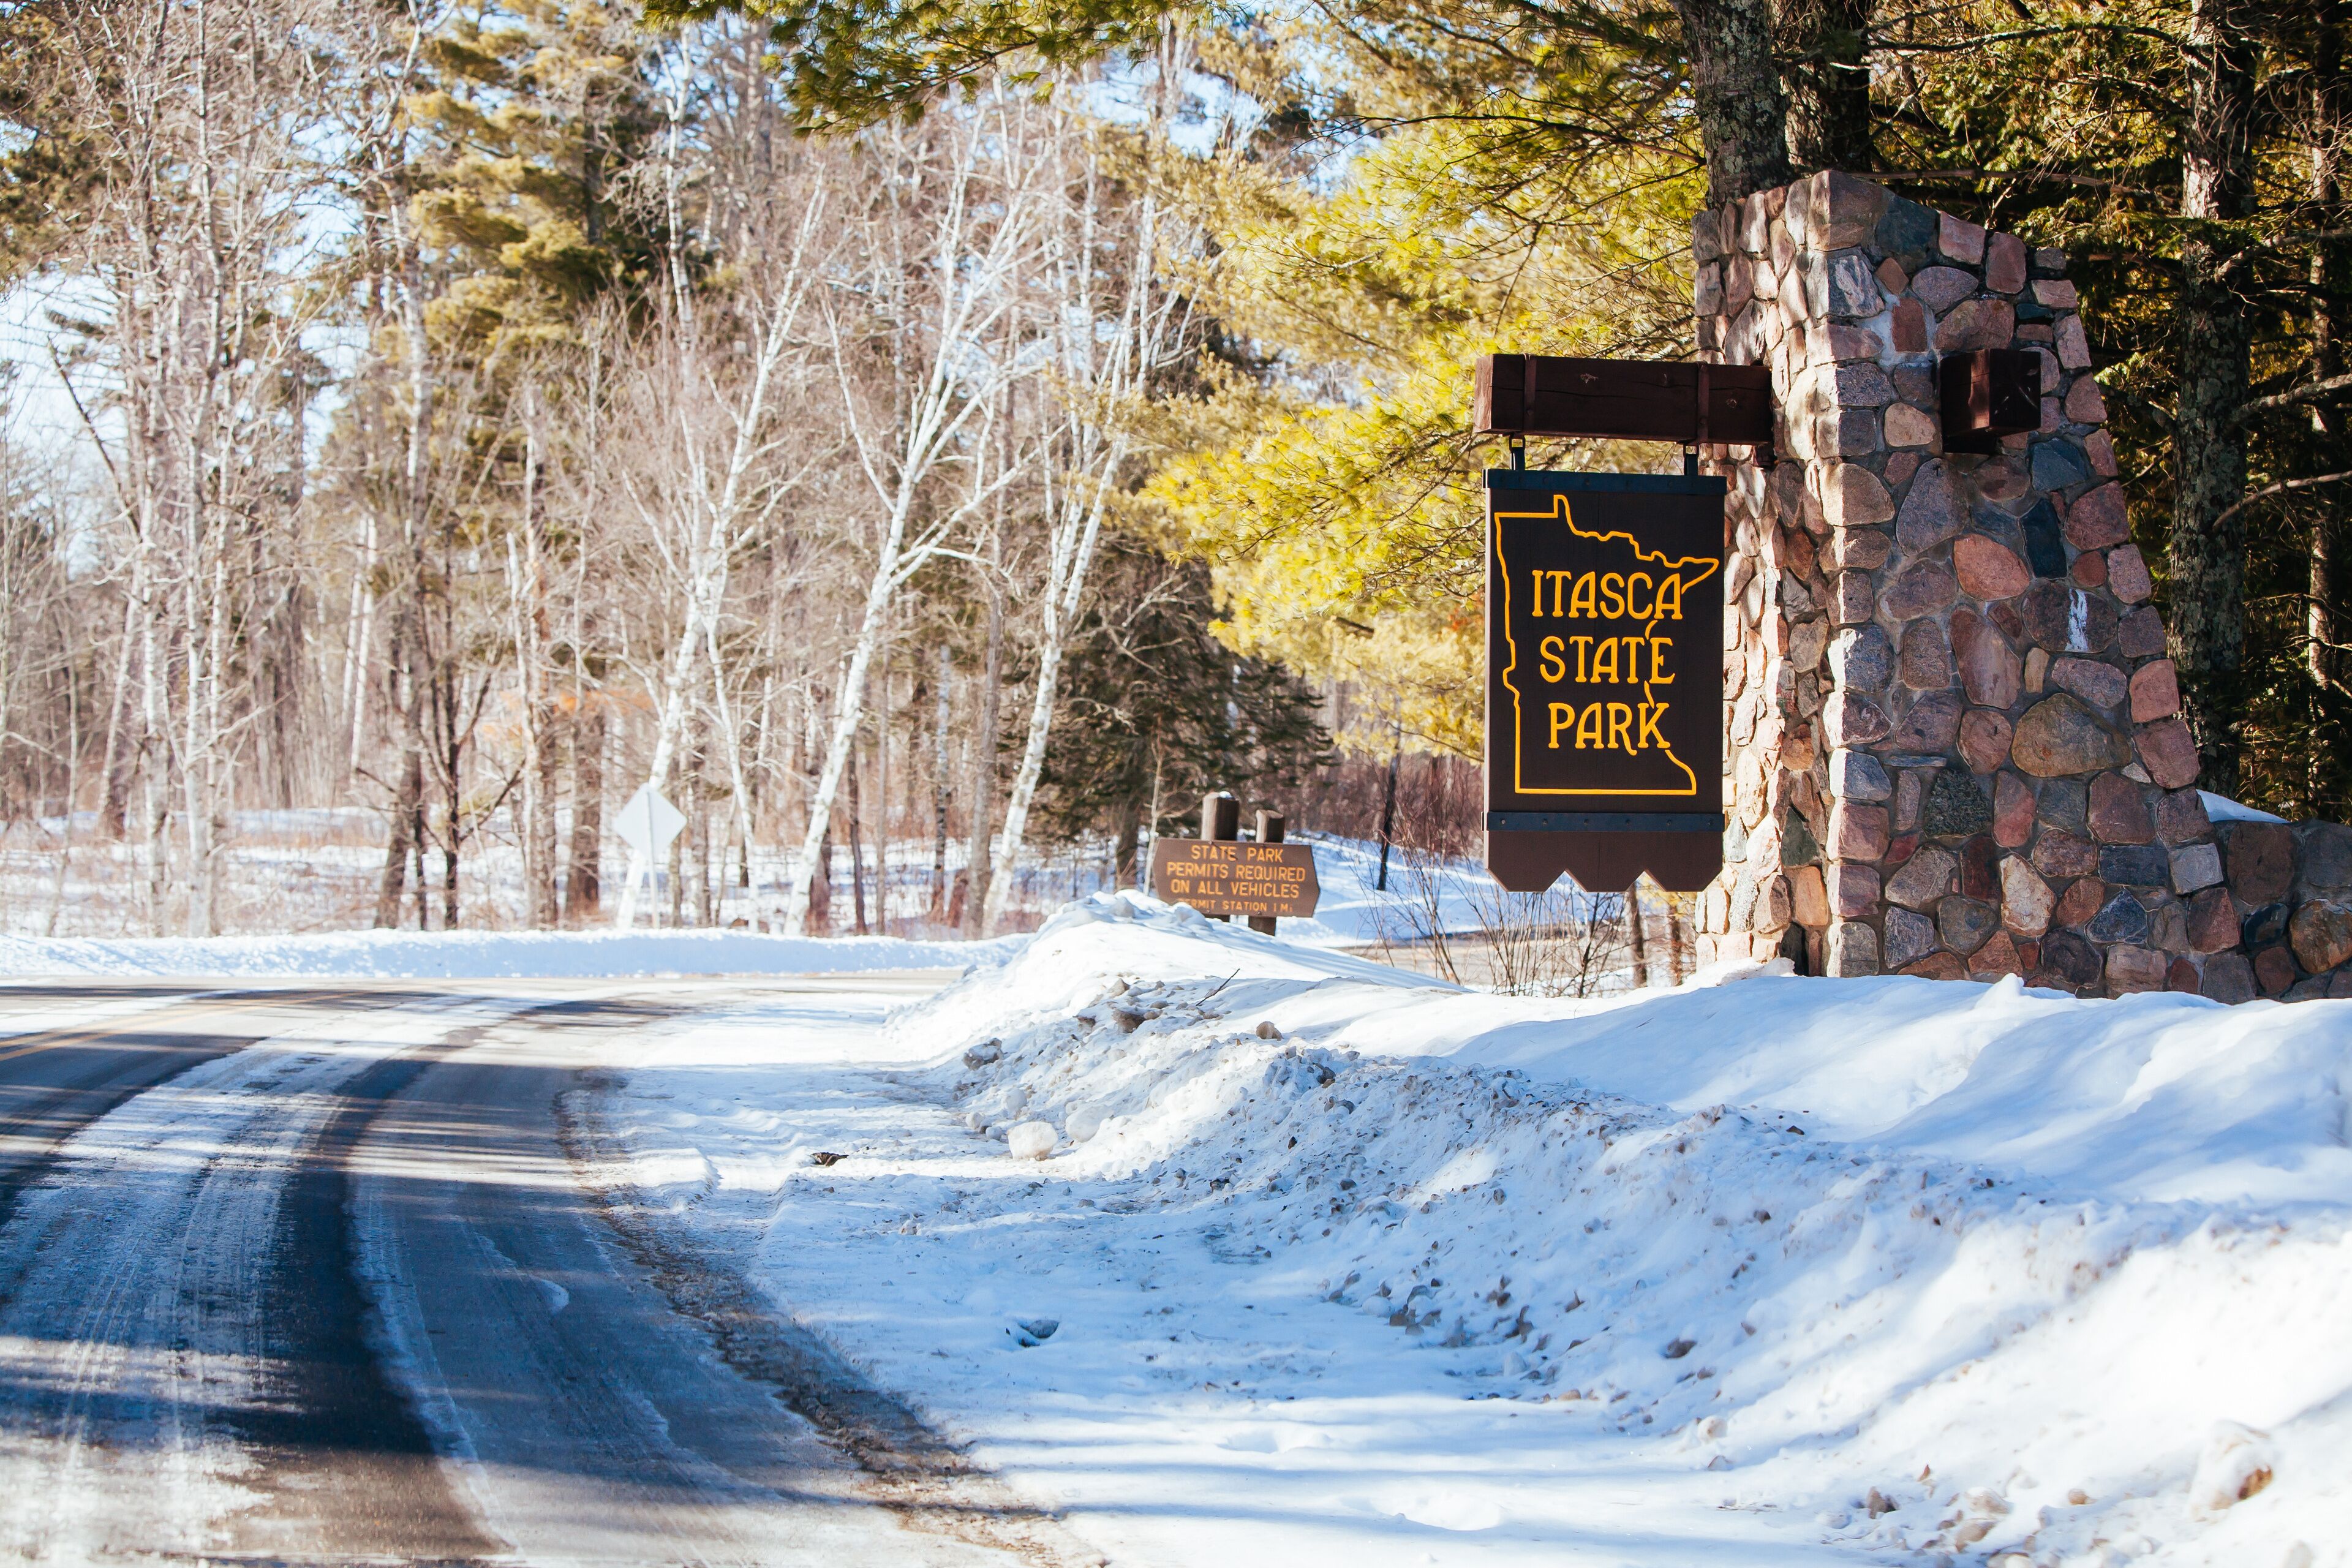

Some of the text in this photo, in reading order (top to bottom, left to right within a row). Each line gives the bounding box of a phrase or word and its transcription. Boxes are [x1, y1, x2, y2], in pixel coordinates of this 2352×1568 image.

[1532, 570, 1683, 620] ITASCA
[1540, 636, 1675, 684] STATE
[1548, 702, 1671, 756] PARK
[1191, 845, 1284, 862] STATE PARK
[1166, 862, 1306, 882] PERMITS REQUIRED
[1170, 880, 1300, 898] ON ALL VEHICLES
[1223, 900, 1267, 911] STATION
